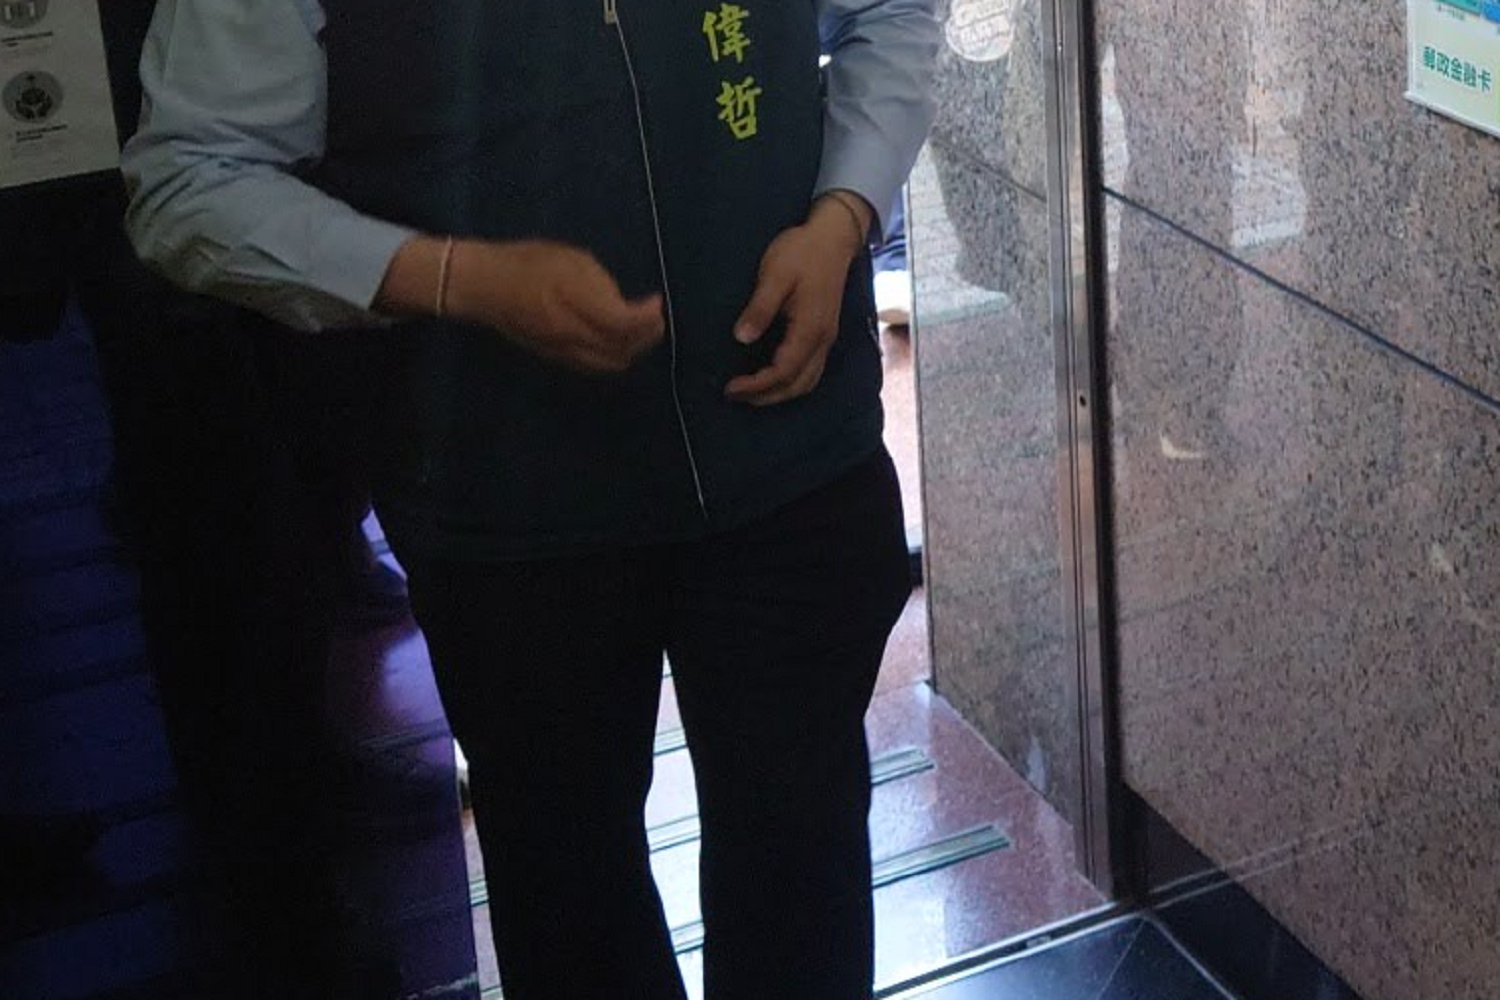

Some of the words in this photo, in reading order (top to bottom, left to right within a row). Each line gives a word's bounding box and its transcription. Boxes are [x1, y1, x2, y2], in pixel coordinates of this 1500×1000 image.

[1422, 45, 1492, 92] 郵政金融卡
